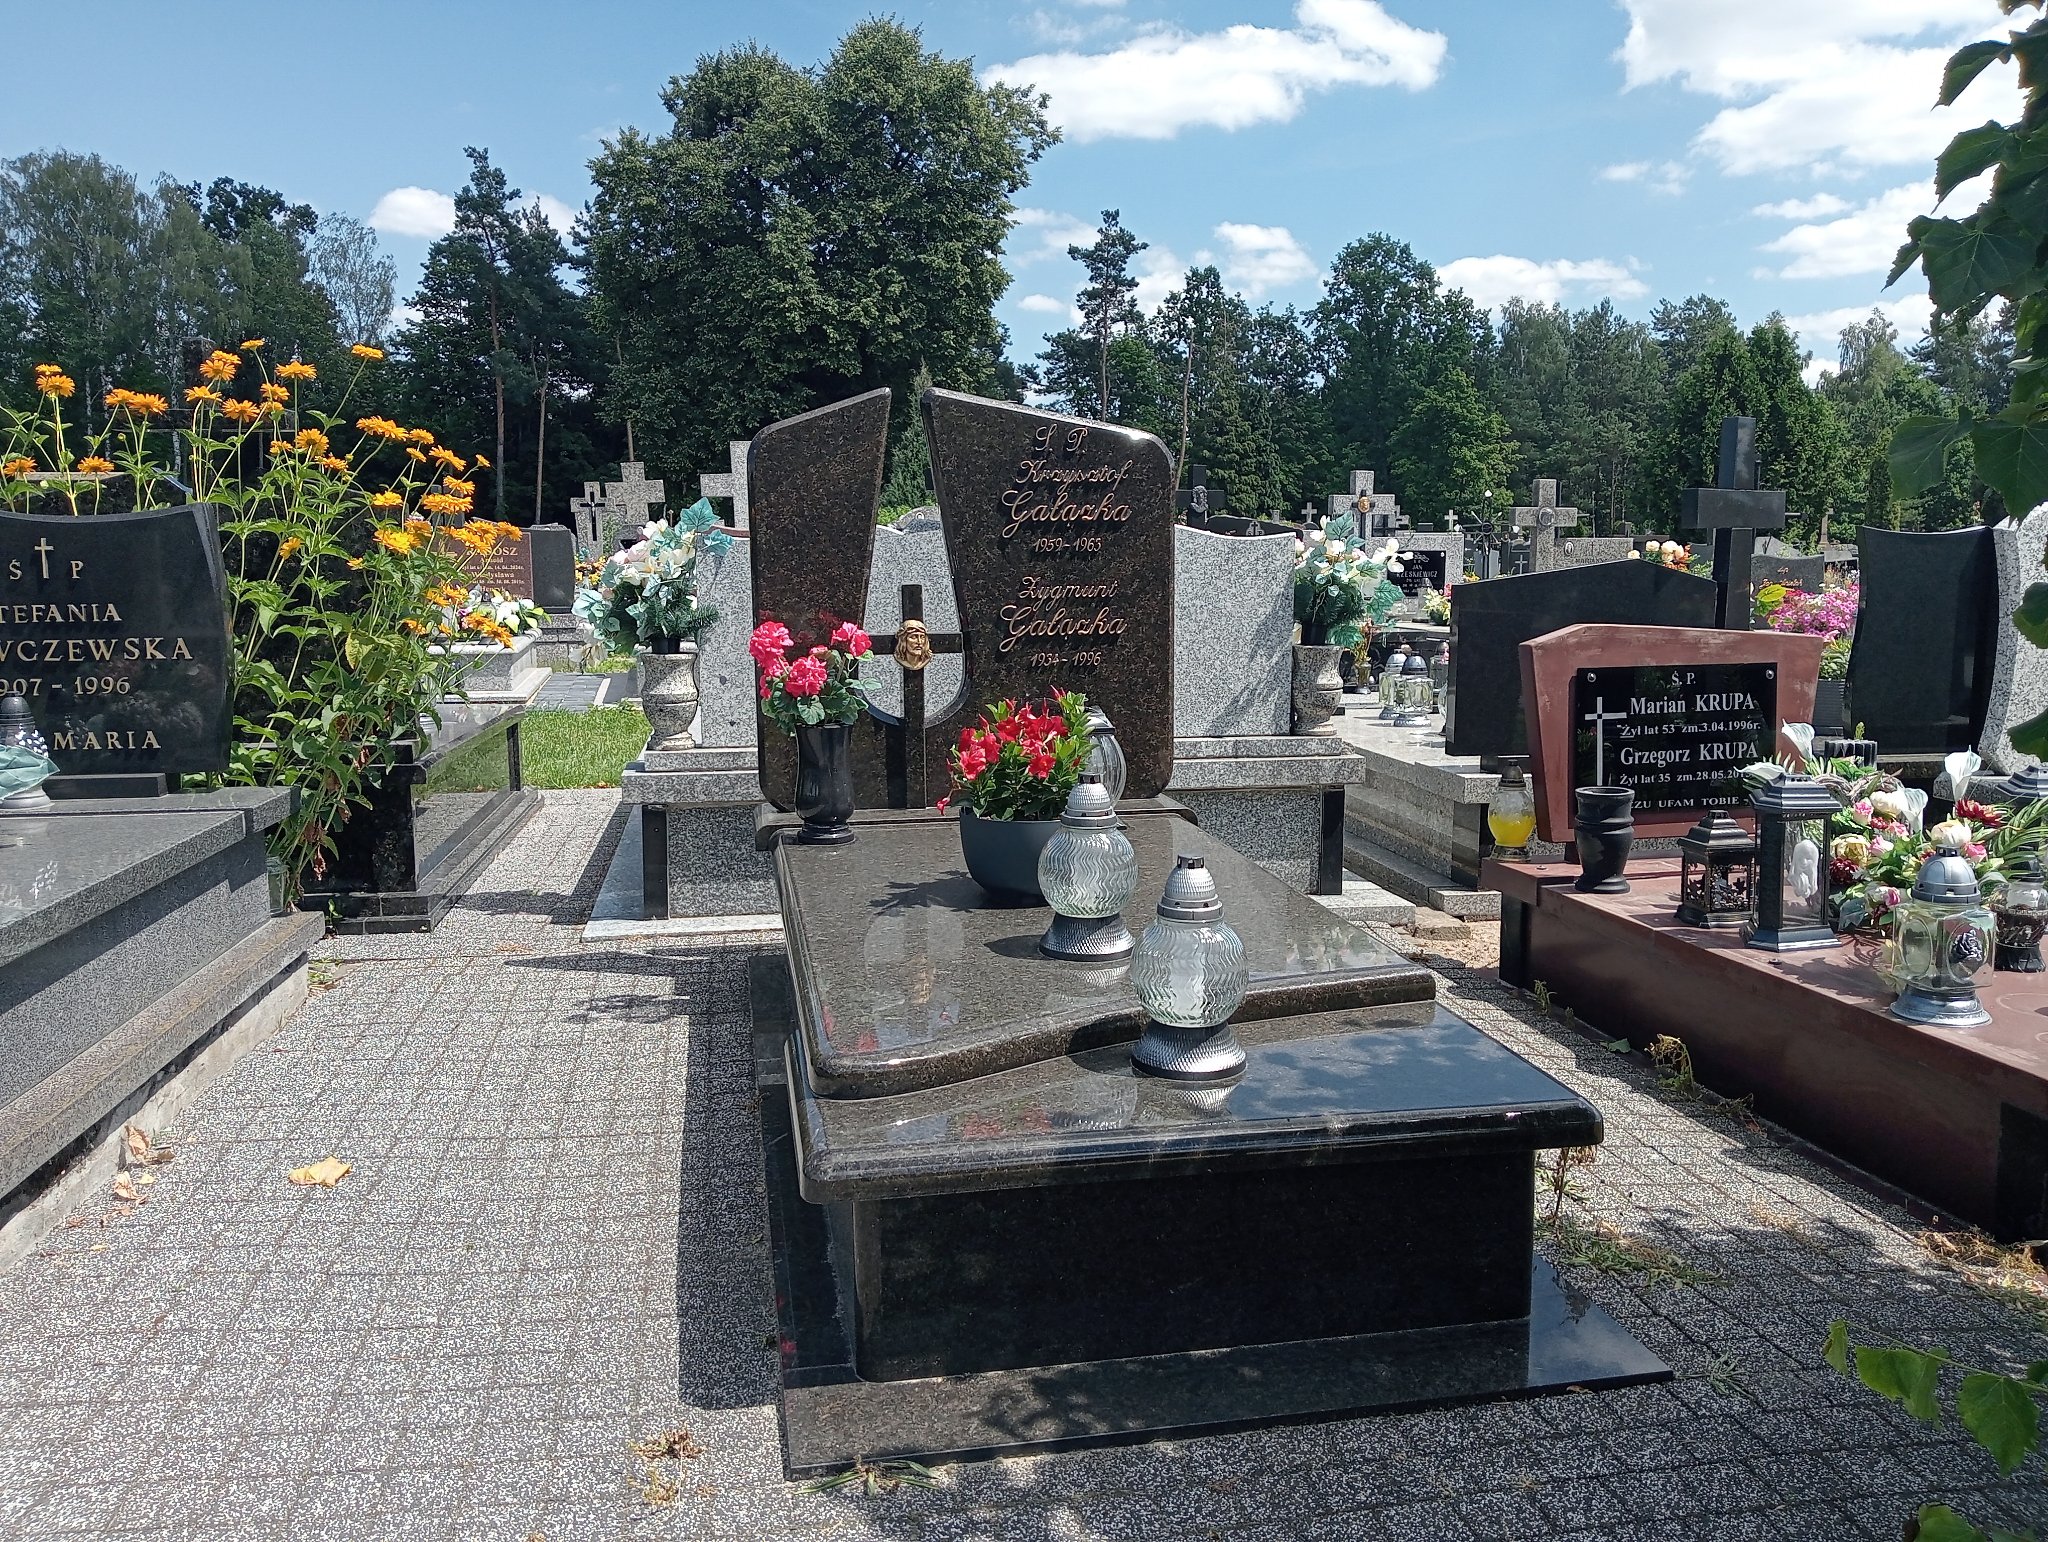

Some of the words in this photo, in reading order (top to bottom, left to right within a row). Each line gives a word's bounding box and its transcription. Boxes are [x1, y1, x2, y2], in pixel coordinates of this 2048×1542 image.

[1015, 459, 1133, 495] Krzysztof
[9, 558, 23, 580] Ś
[70, 560, 84, 579] P
[1019, 576, 1118, 611] Zygmunt
[1072, 651, 1102, 666] 1996
[74, 676, 132, 696] 1996
[1630, 695, 1686, 715] Marian
[1695, 692, 1755, 712] KRUPA
[1644, 725, 1659, 735] lat
[1662, 724, 1676, 735] 53
[53, 730, 162, 751] MARIA
[1620, 747, 1691, 768] Grzegorz
[1699, 741, 1759, 761] KRUPA
[1641, 774, 1655, 784] lat
[1658, 773, 1671, 783] 35
[1630, 799, 1651, 809] ZU
[1658, 799, 1694, 808] UFAM
[1701, 796, 1740, 806] TOBIE
